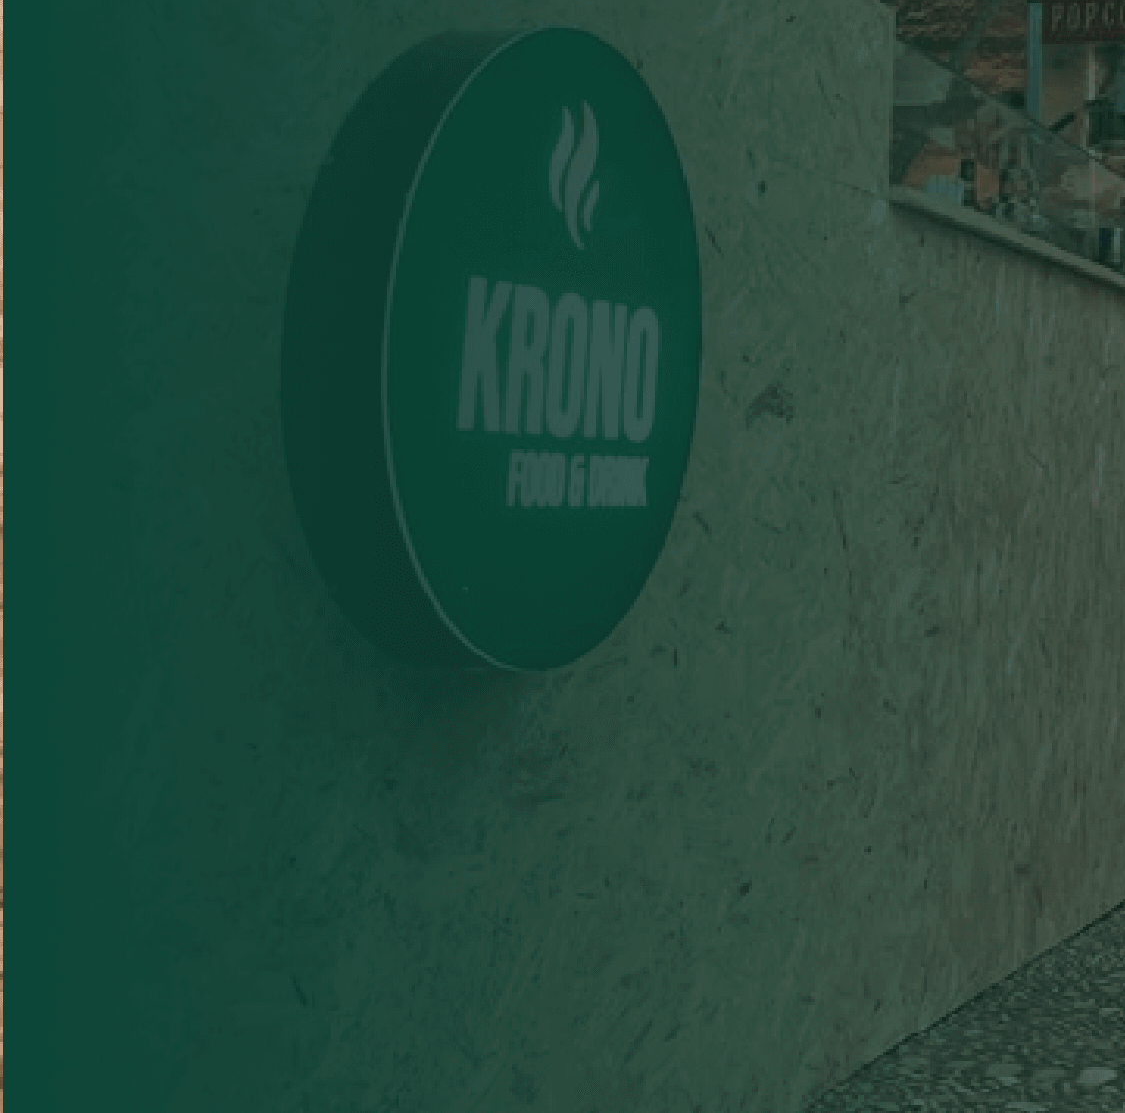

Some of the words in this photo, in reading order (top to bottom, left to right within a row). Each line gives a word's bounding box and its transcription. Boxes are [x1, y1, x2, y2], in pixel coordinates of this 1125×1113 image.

[457, 276, 659, 443] KRONO
[506, 449, 567, 508] FOOD
[568, 453, 586, 508] &
